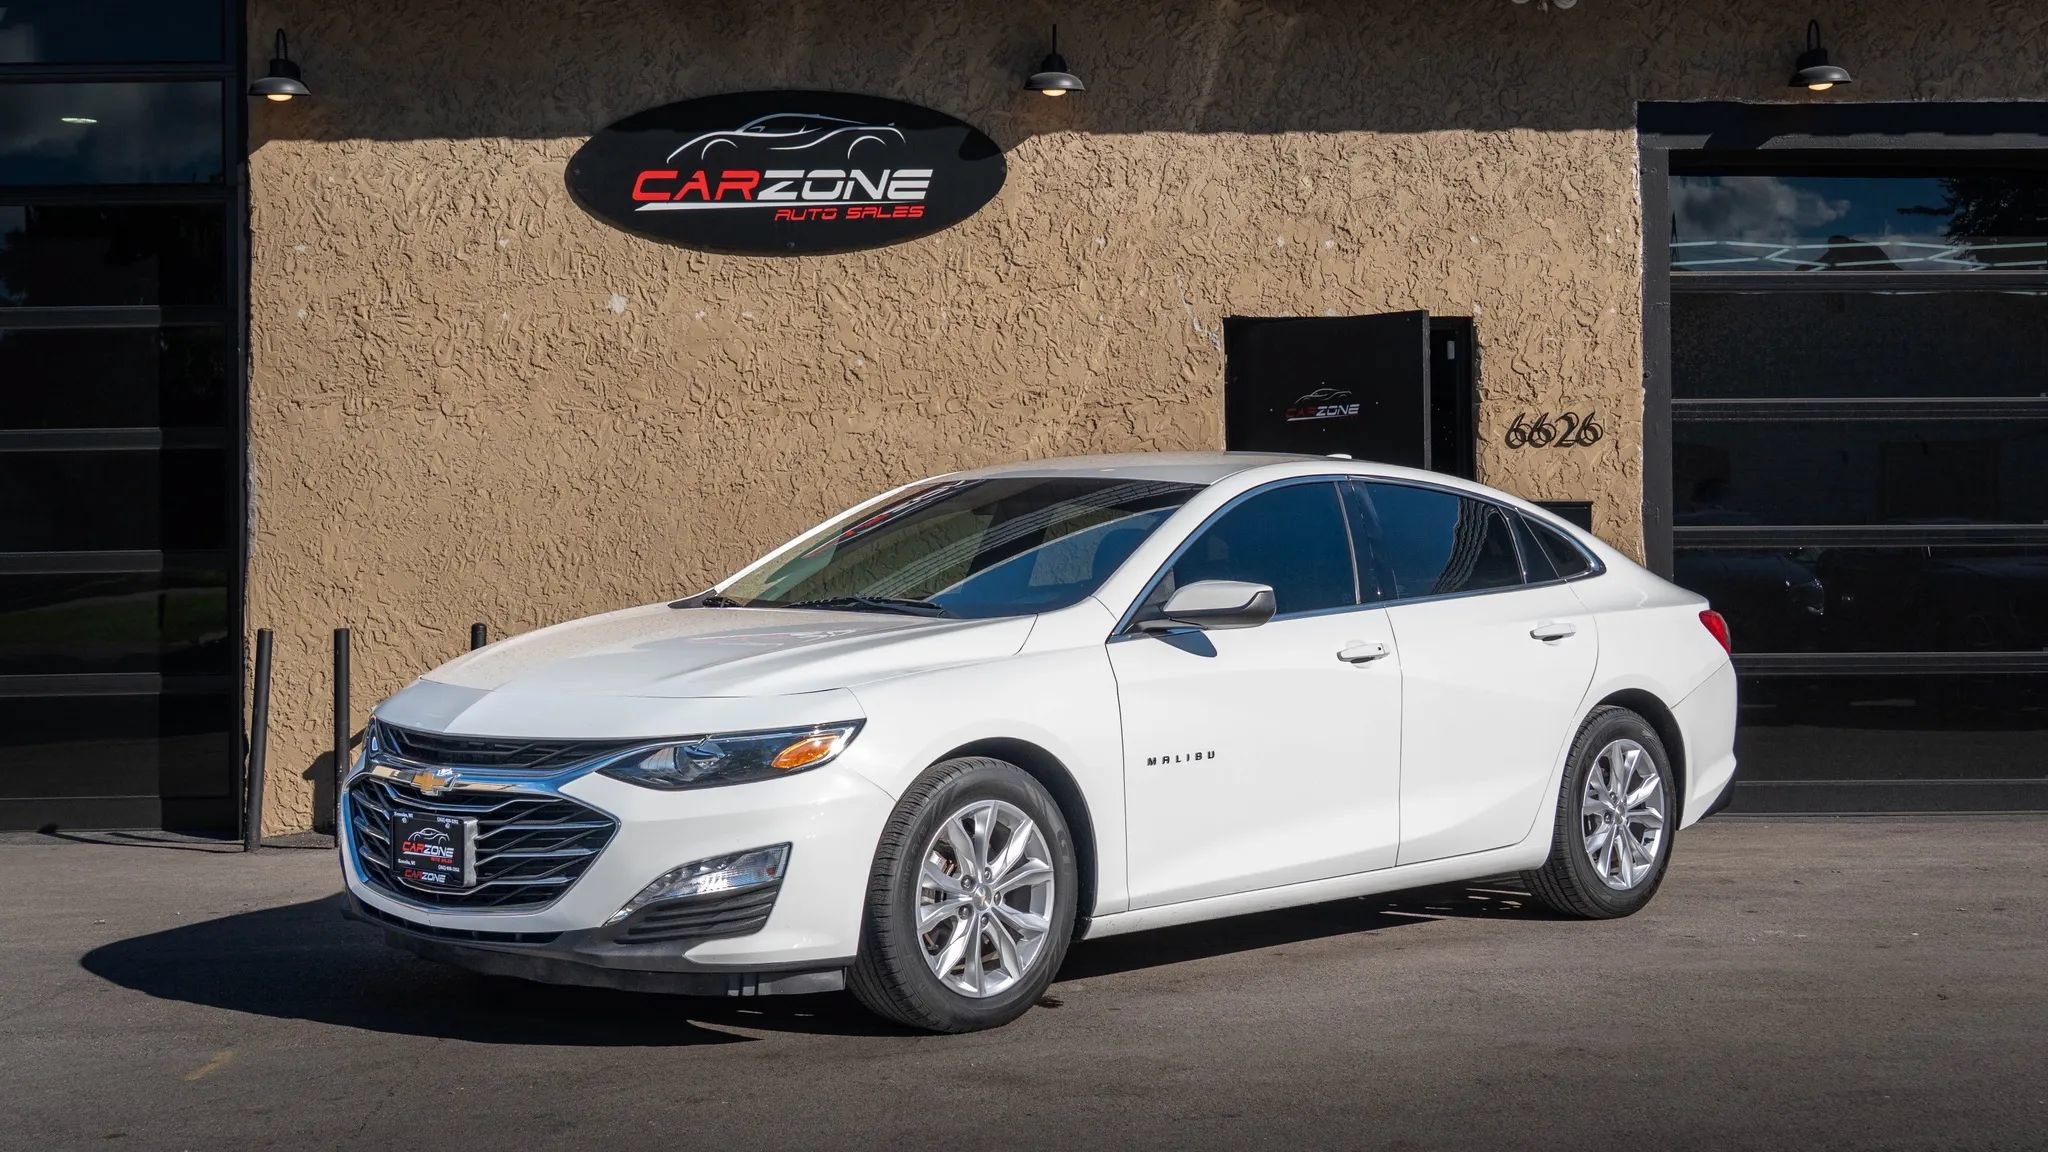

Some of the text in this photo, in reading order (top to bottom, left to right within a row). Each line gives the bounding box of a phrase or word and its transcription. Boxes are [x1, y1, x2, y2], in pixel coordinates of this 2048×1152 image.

[632, 169, 933, 200] CARZONE
[774, 205, 925, 221] AUTO SALES
[1504, 411, 1604, 449] 6626
[1147, 750, 1215, 766] MALIBU
[402, 841, 454, 858] CARZONE
[404, 868, 446, 883] CARZONE
